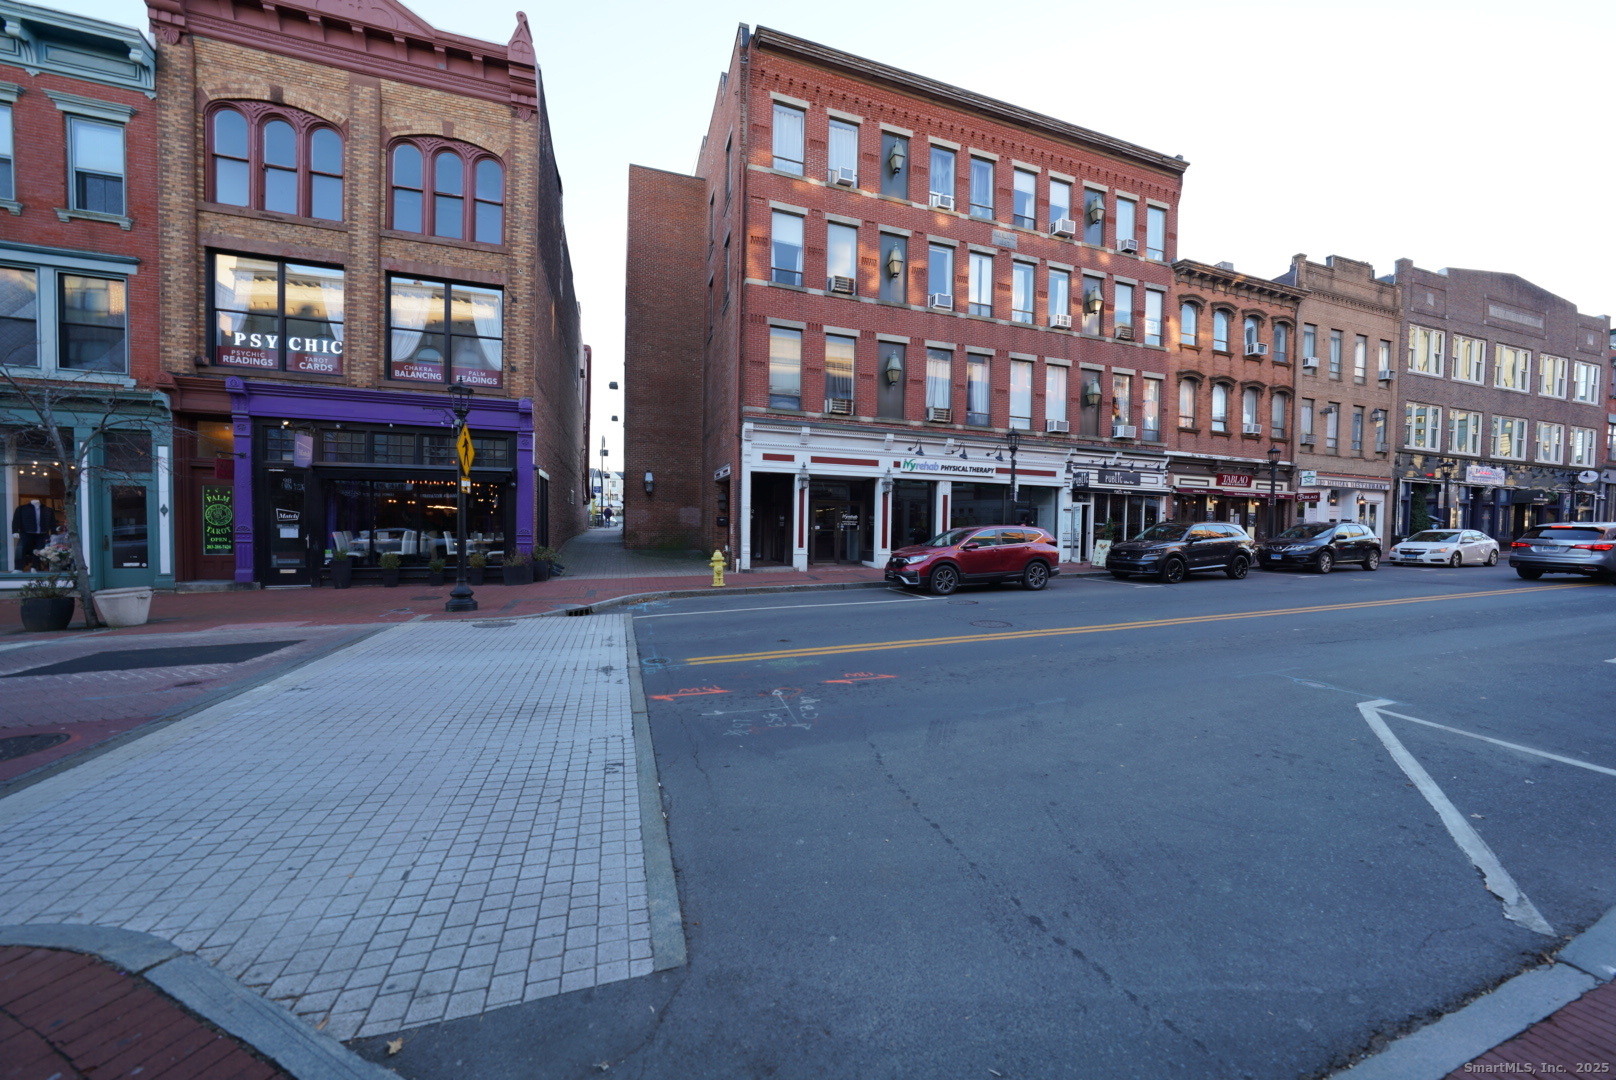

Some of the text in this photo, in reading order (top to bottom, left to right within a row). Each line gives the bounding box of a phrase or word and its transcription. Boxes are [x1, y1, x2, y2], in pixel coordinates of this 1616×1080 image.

[231, 350, 265, 358] PSYCHIC
[222, 355, 274, 367] READINGS
[304, 356, 328, 364] TAROT
[299, 362, 333, 372] CARDS
[404, 364, 433, 373] CHAKRA
[394, 370, 442, 381] BALANCING
[940, 464, 968, 473] PHYSICAL
[1105, 472, 1123, 484] PUBLIC
[1222, 474, 1249, 484] TABLAO
[206, 495, 230, 503] PALM
[206, 526, 231, 535] TAROT
